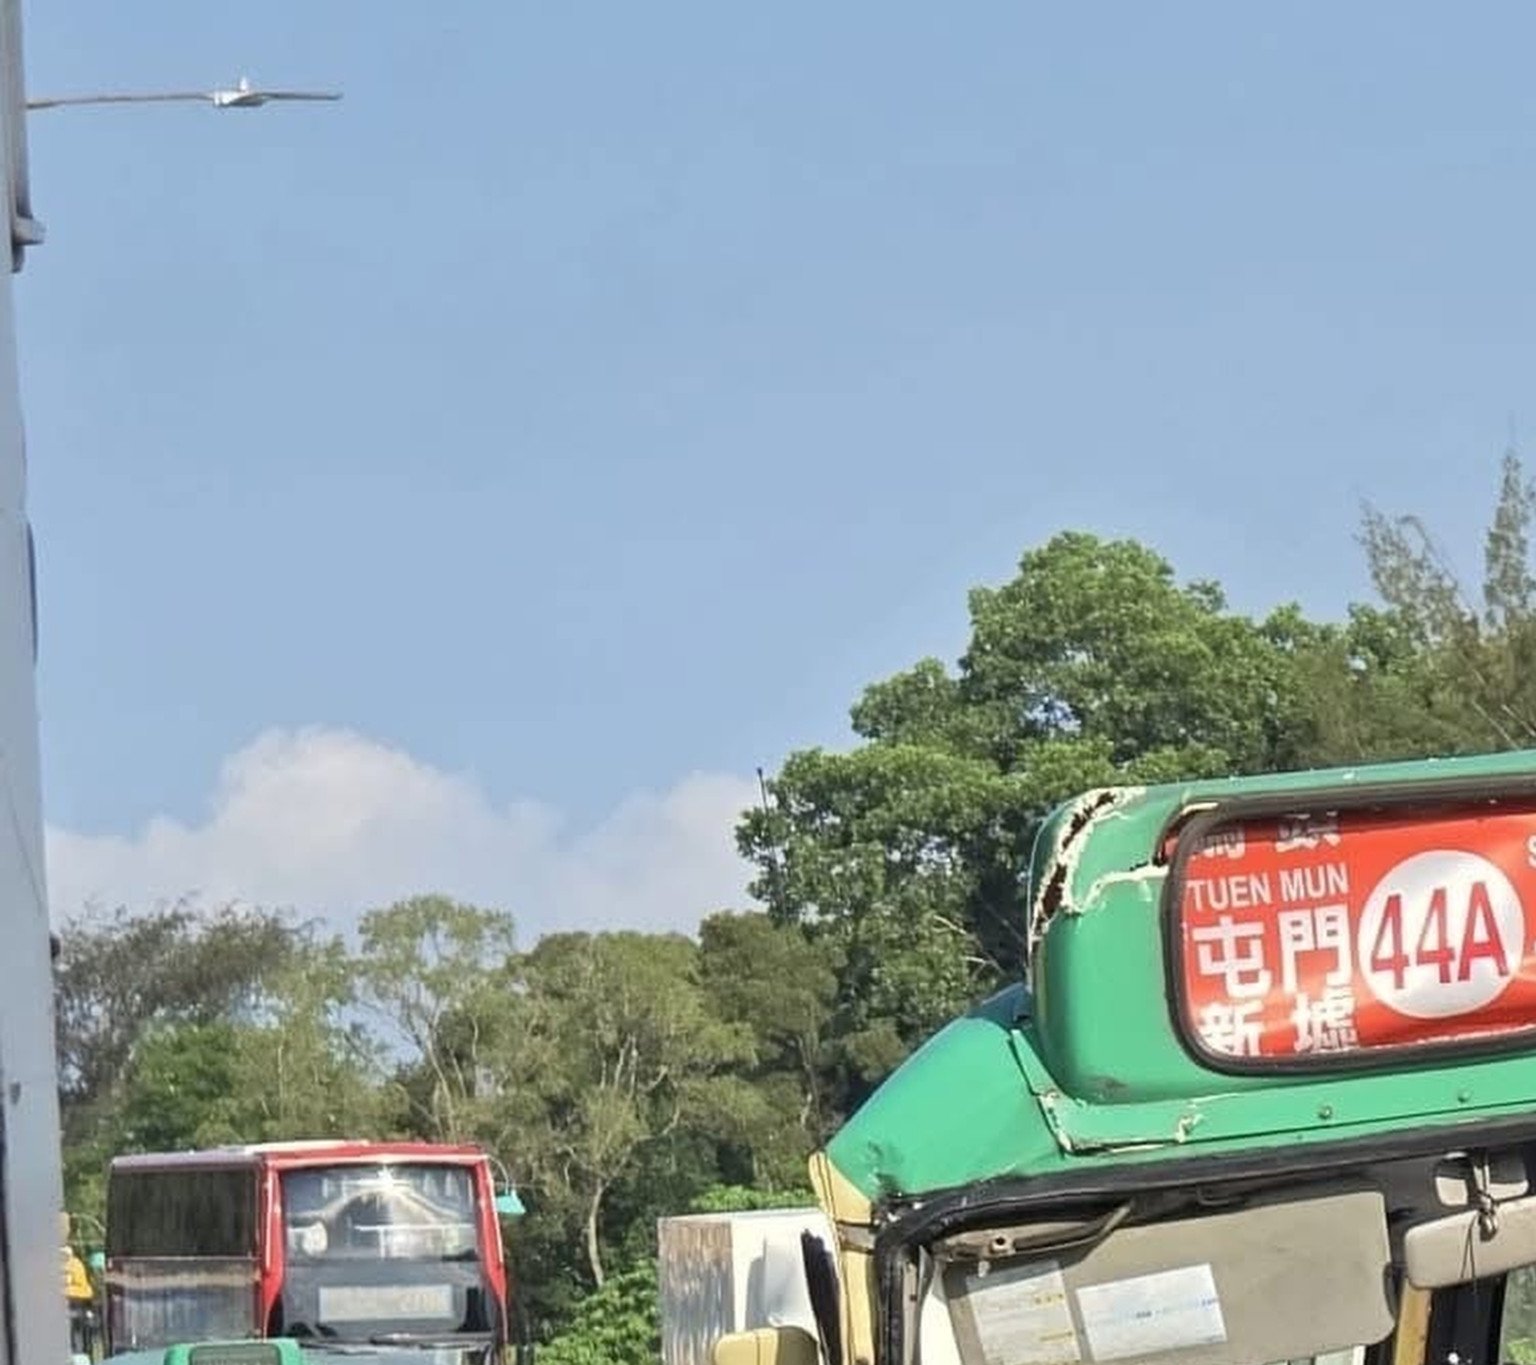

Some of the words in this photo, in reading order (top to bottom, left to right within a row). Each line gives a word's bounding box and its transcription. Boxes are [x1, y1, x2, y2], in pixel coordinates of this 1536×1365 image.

[1186, 872, 1273, 912] TUEN
[1279, 862, 1350, 902] MUN
[1371, 880, 1510, 990] 44A
[1191, 904, 1354, 1000] 屯門
